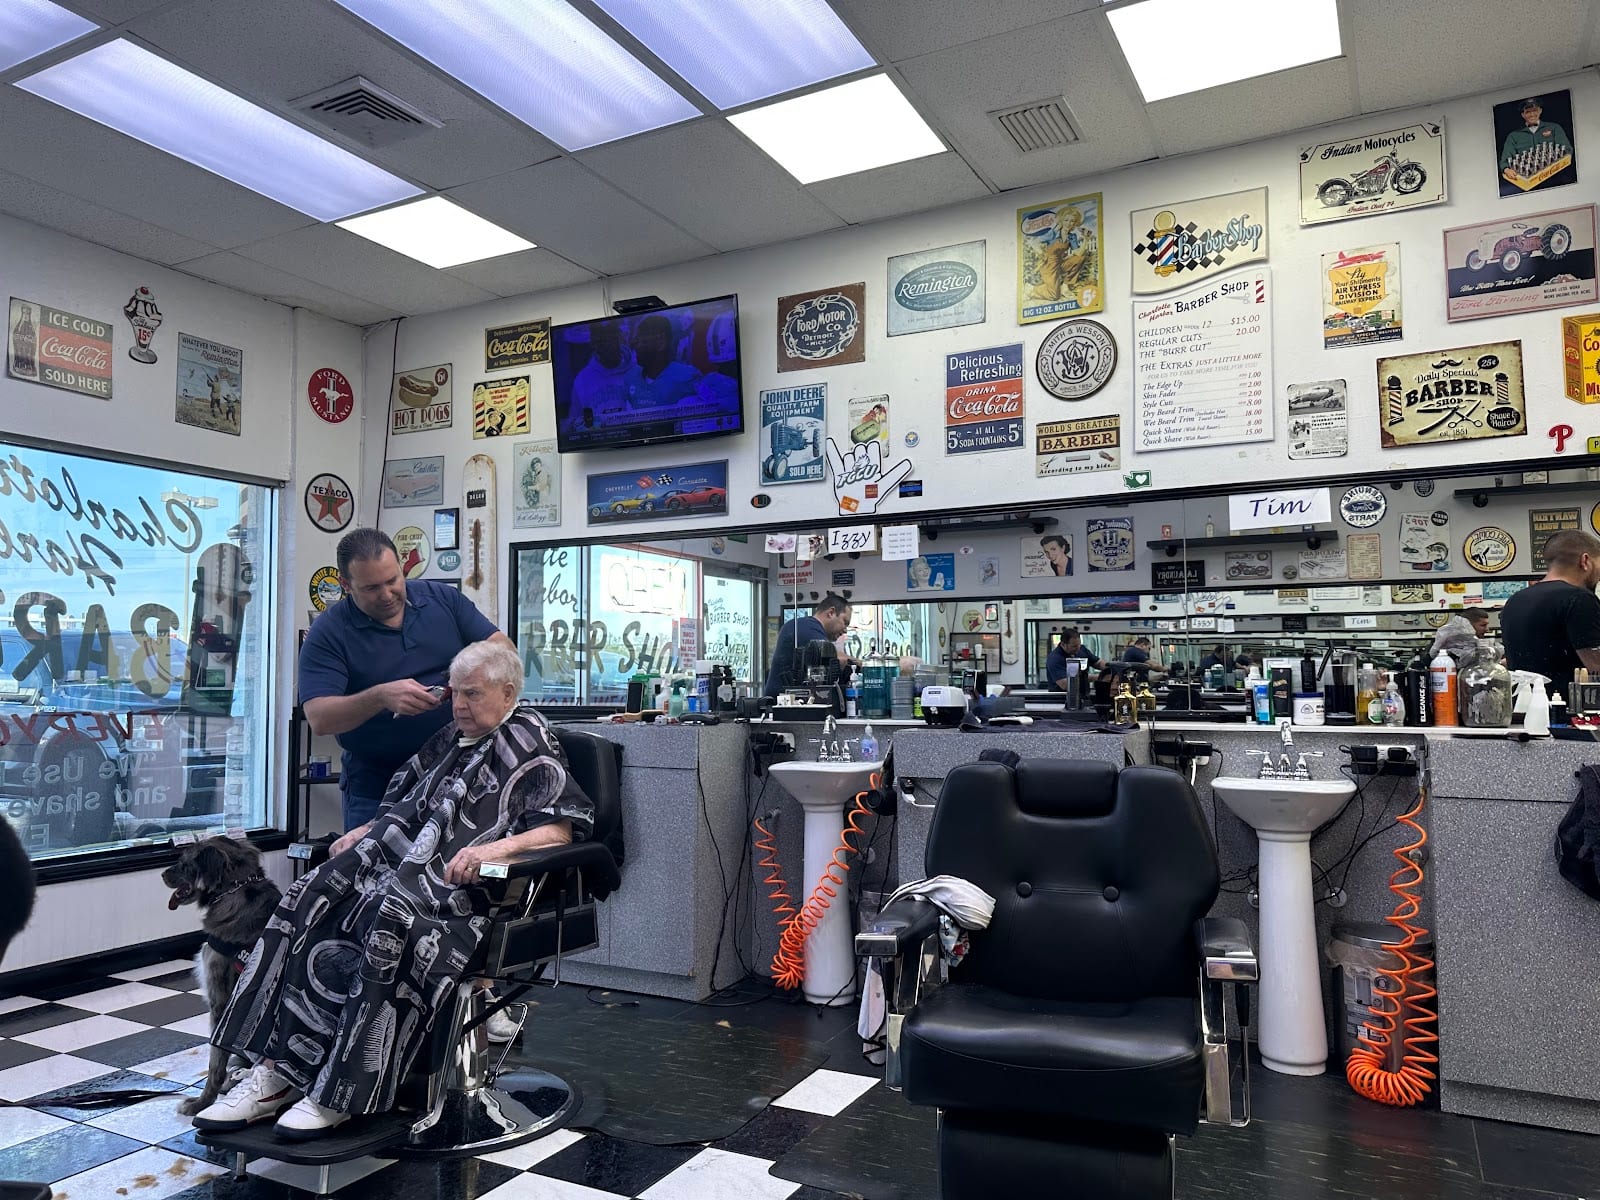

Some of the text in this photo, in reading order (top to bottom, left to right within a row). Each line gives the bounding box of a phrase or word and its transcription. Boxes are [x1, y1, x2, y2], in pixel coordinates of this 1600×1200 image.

[1321, 131, 1416, 160] Indian Motocycles
[1338, 290, 1378, 300] DIVISION
[1350, 282, 1381, 293] EXPRESS
[1175, 281, 1249, 313] BARBER SHOP
[1023, 307, 1034, 317] BIG
[1036, 306, 1042, 314] 12
[1054, 301, 1076, 312] BOTTLE
[1138, 303, 1171, 320] Charlotte
[49, 312, 105, 337] ICE COLD
[797, 311, 846, 332] FORD MOTOR
[826, 323, 843, 332] CO.
[1138, 314, 1260, 338] CHILDREN 12 $15.00
[488, 330, 548, 359] Coca-Cola
[1046, 331, 1066, 354] SMITH
[1076, 326, 1106, 346] WESSON
[1138, 326, 1261, 348] REGULAR CUTS 20.00
[42, 337, 107, 370] Coca-Cola
[950, 354, 1003, 370] Delicious
[1139, 350, 1155, 359] THE
[1140, 363, 1156, 373] THE
[1160, 359, 1193, 370] EXTRAS
[1219, 354, 1240, 363] LITTLE
[1242, 352, 1263, 360] MORE
[1481, 358, 1496, 367] 25¢
[45, 369, 108, 393] SOLD HERE
[317, 371, 345, 385] FORD
[960, 364, 1022, 382] Refreshing
[1415, 368, 1479, 383] Daily Specials
[966, 385, 997, 397] DRINK
[1156, 381, 1172, 390] Edge
[1173, 379, 1183, 388] Up
[1158, 390, 1176, 398] Fades
[1248, 380, 1261, 388] 2.00
[1405, 379, 1494, 407] BARBER
[762, 386, 824, 404] JOHN DEERE
[1143, 401, 1158, 409] Style
[1248, 389, 1261, 397] 2.00
[1436, 398, 1464, 407] SHOP
[311, 396, 352, 422] MUSTANG
[766, 403, 797, 412] QUALITY
[949, 392, 1021, 419] Coca-Cola
[1143, 410, 1155, 418] Dry
[1178, 406, 1194, 414] Trim
[394, 409, 415, 427] HOT
[420, 404, 450, 422] DOGS
[1157, 417, 1176, 425] Beard
[1490, 412, 1511, 421] Shave
[1491, 419, 1517, 427] Haircut
[1038, 418, 1118, 435] WORLD'S GREATEST
[1143, 428, 1161, 436] Quick
[1164, 427, 1182, 435] Shave
[960, 435, 1006, 448] SODA FOUNTAINS
[1041, 432, 1114, 451] BARBER
[1143, 437, 1161, 446] Quick
[1245, 428, 1262, 436] 15.00
[789, 464, 822, 477] SOLD HERE
[837, 465, 878, 488] FGCU
[1039, 466, 1073, 474] According
[313, 485, 348, 499] TEXACO
[605, 484, 633, 493] CHEVROLET
[1250, 497, 1312, 517] Tim
[832, 530, 871, 550] Izzy
[311, 568, 328, 587] WHITE
[710, 612, 749, 626] BARBER SHOP
[707, 643, 748, 654] FOR MEN
